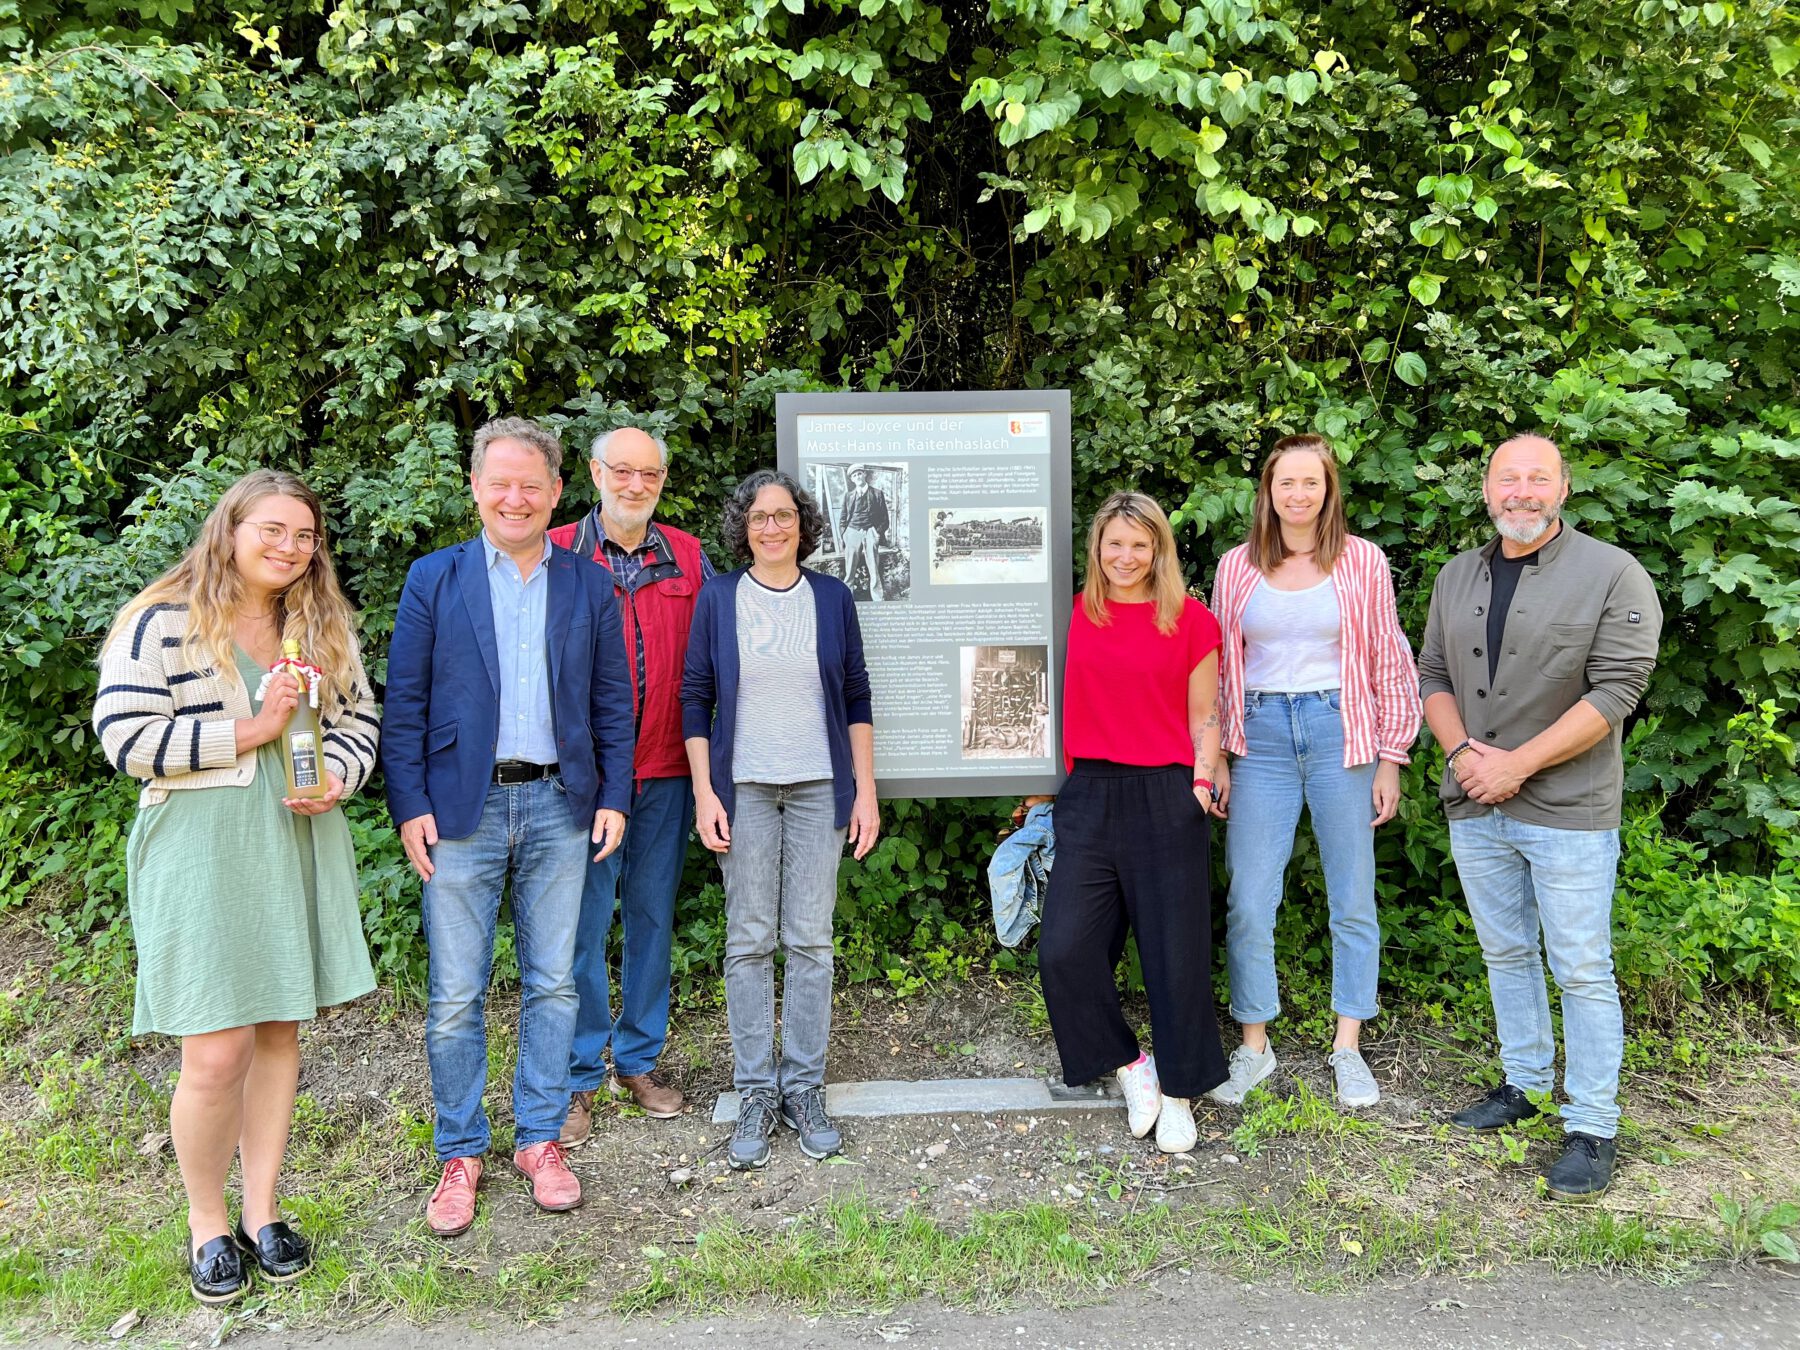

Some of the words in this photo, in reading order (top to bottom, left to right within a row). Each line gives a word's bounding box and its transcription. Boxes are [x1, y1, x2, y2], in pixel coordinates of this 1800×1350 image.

[807, 417, 853, 433] James
[858, 416, 902, 437] Joyce
[906, 415, 934, 432] und
[939, 415, 963, 431] der
[806, 438, 882, 453] Most-Hans
[888, 438, 901, 451] in
[906, 436, 1009, 451] Raitenhaslach
